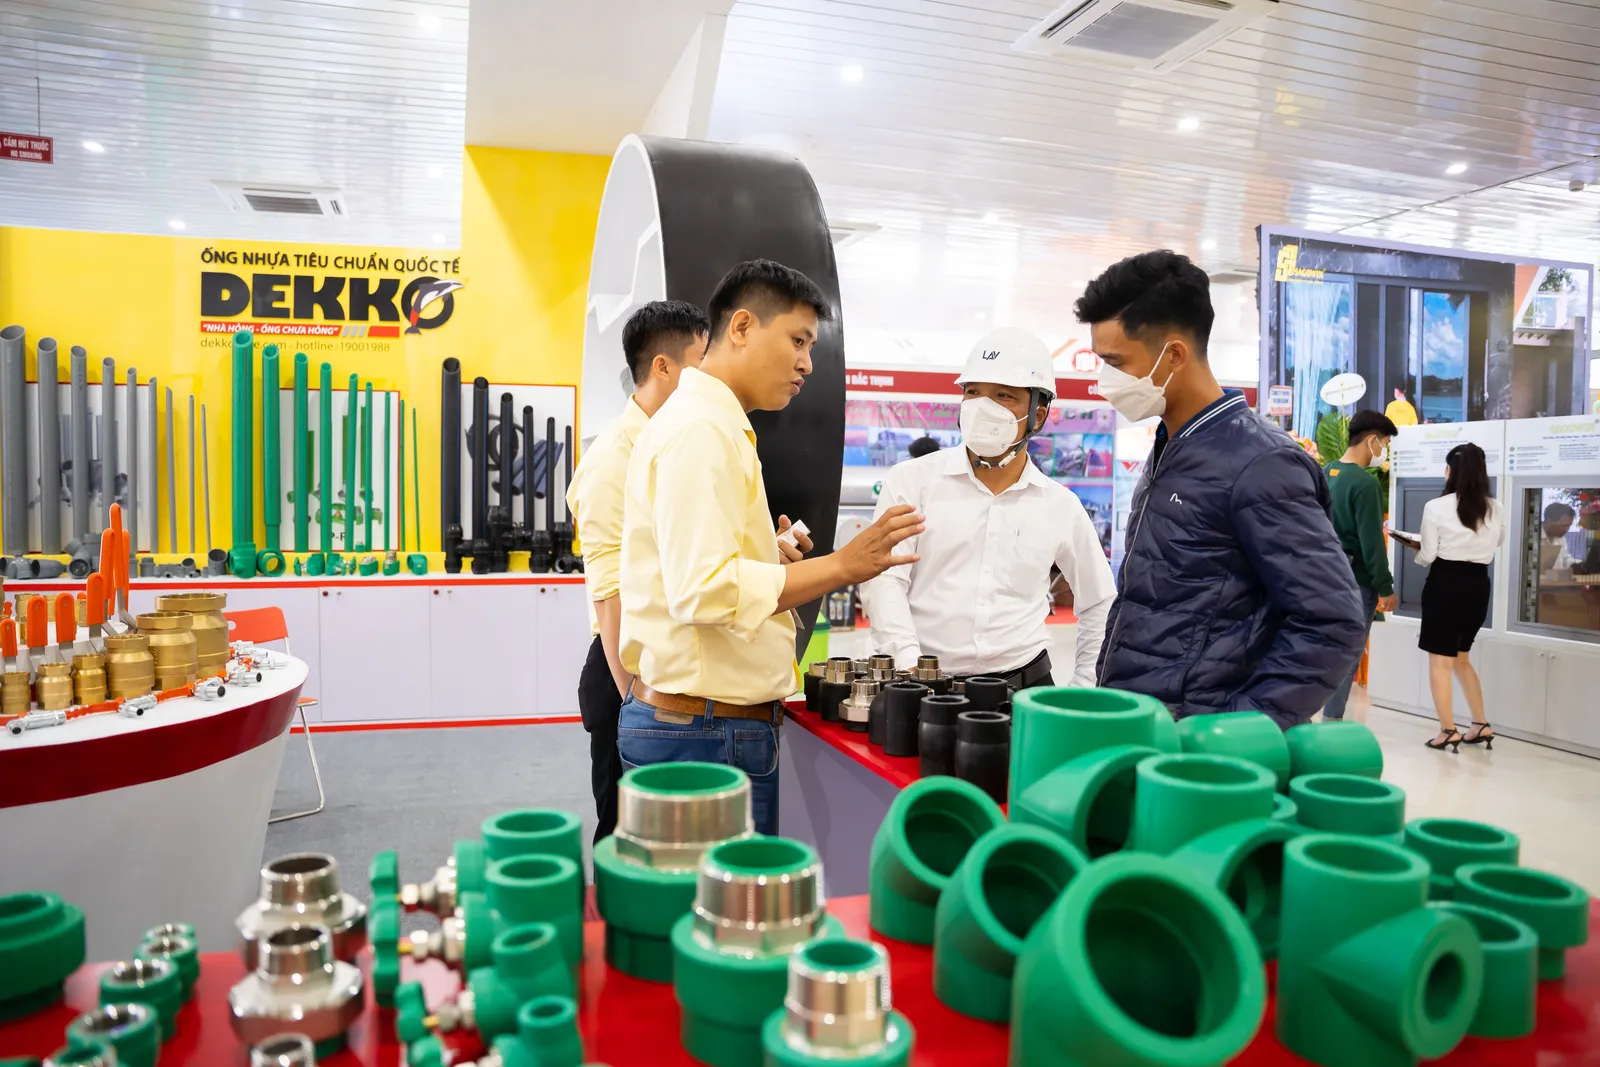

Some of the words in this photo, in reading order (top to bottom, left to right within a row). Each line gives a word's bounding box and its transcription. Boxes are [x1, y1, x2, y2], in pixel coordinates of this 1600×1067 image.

[10, 149, 18, 157] NO
[201, 247, 238, 264] ỐNG
[243, 251, 290, 270] NHỰA
[294, 252, 328, 268] TIÊU
[334, 252, 389, 270] CHUẨN
[394, 255, 439, 273] QUỐC
[442, 256, 461, 273] TẾ
[201, 272, 455, 329] DEKKO
[260, 323, 281, 334] ỐNG
[282, 325, 306, 334] CHƯA
[296, 340, 333, 351] hotline
[340, 341, 390, 352] 19001988
